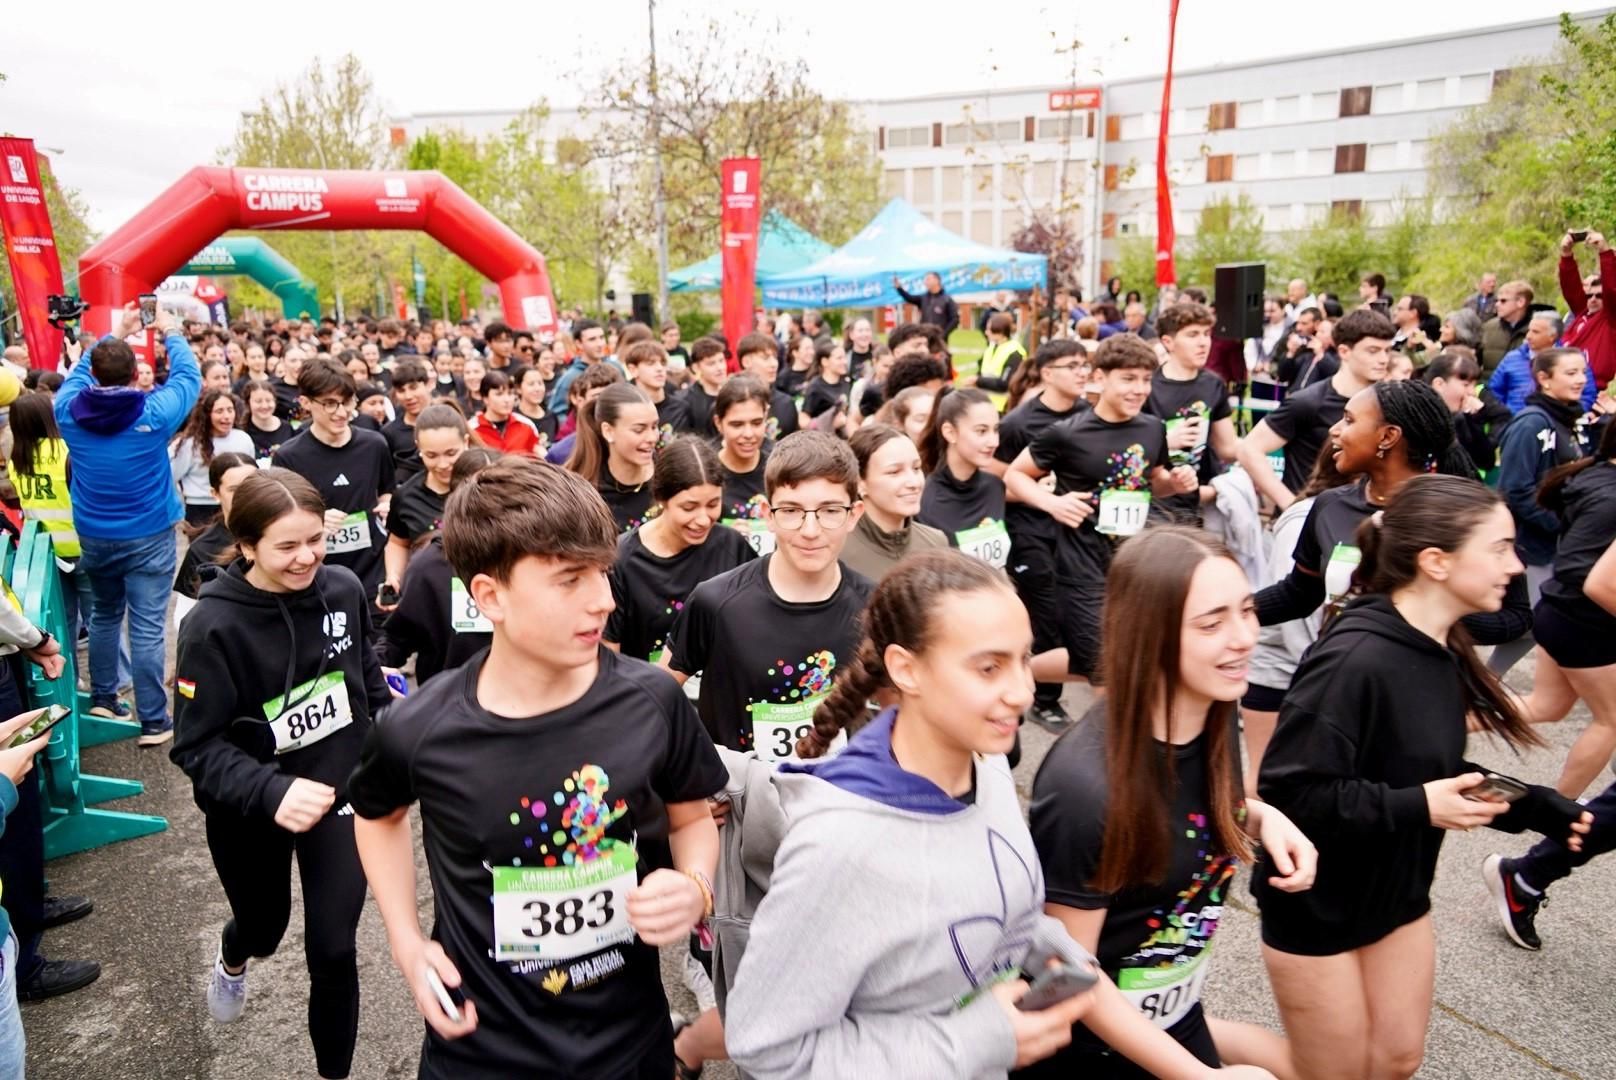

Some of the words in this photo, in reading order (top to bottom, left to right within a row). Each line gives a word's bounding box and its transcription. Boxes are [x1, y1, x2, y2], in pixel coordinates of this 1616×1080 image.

[244, 174, 329, 193] CARRERA
[246, 191, 324, 211] CAMPUS
[20, 473, 57, 500] UR
[1113, 505, 1141, 526] 111
[972, 539, 1002, 562] 108
[286, 693, 338, 741] 864
[521, 889, 616, 938] 383
[1140, 976, 1195, 1021] 801
